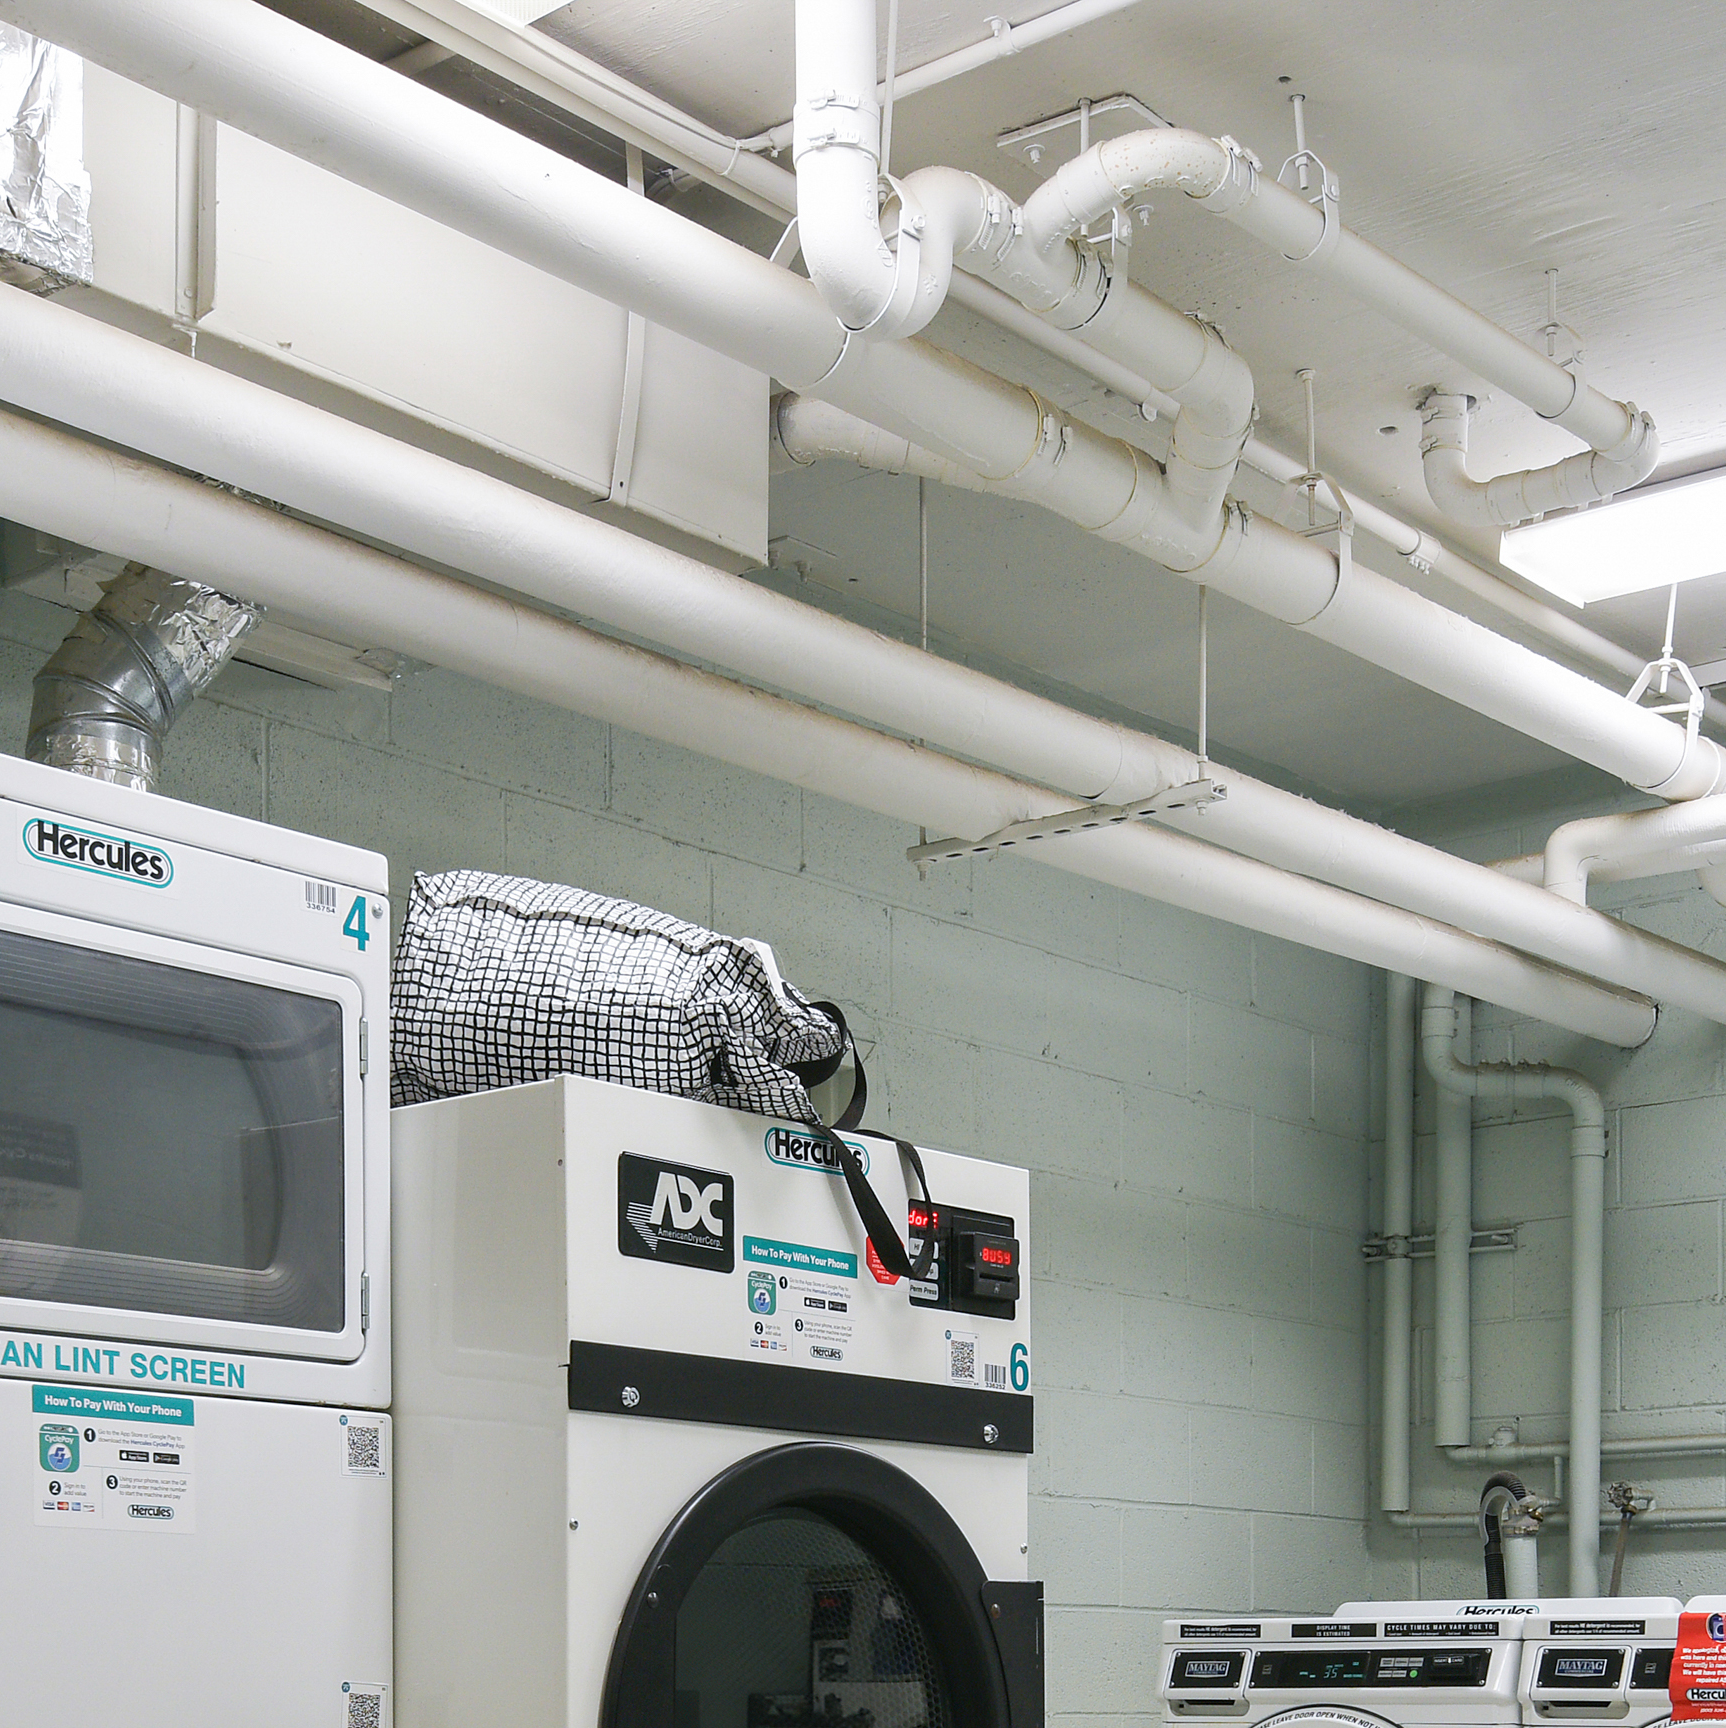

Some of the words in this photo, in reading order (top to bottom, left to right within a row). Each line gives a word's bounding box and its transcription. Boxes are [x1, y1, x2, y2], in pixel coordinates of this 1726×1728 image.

[37, 820, 164, 880] Hercules
[342, 895, 370, 951] 4
[649, 1171, 723, 1237] ADC
[752, 1244, 768, 1257] How
[769, 1248, 778, 1259] To
[779, 1249, 792, 1262] Pay
[793, 1252, 809, 1264] With
[811, 1255, 827, 1267] Your
[827, 1258, 849, 1270] Phone
[812, 1346, 841, 1359] Hercules
[55, 1344, 120, 1375] LINT
[130, 1352, 245, 1389] SCREEN
[1010, 1343, 1029, 1391] 6
[45, 1395, 68, 1408] How
[69, 1397, 82, 1408] To
[84, 1399, 101, 1413] Pay
[102, 1401, 126, 1413] With
[127, 1403, 150, 1415] Your
[152, 1405, 182, 1418] Phone
[131, 1505, 171, 1518] Hercules
[1464, 1606, 1534, 1615] Hercules
[1187, 1662, 1227, 1672] MAYTAG
[1559, 1661, 1603, 1670] MAYTAG
